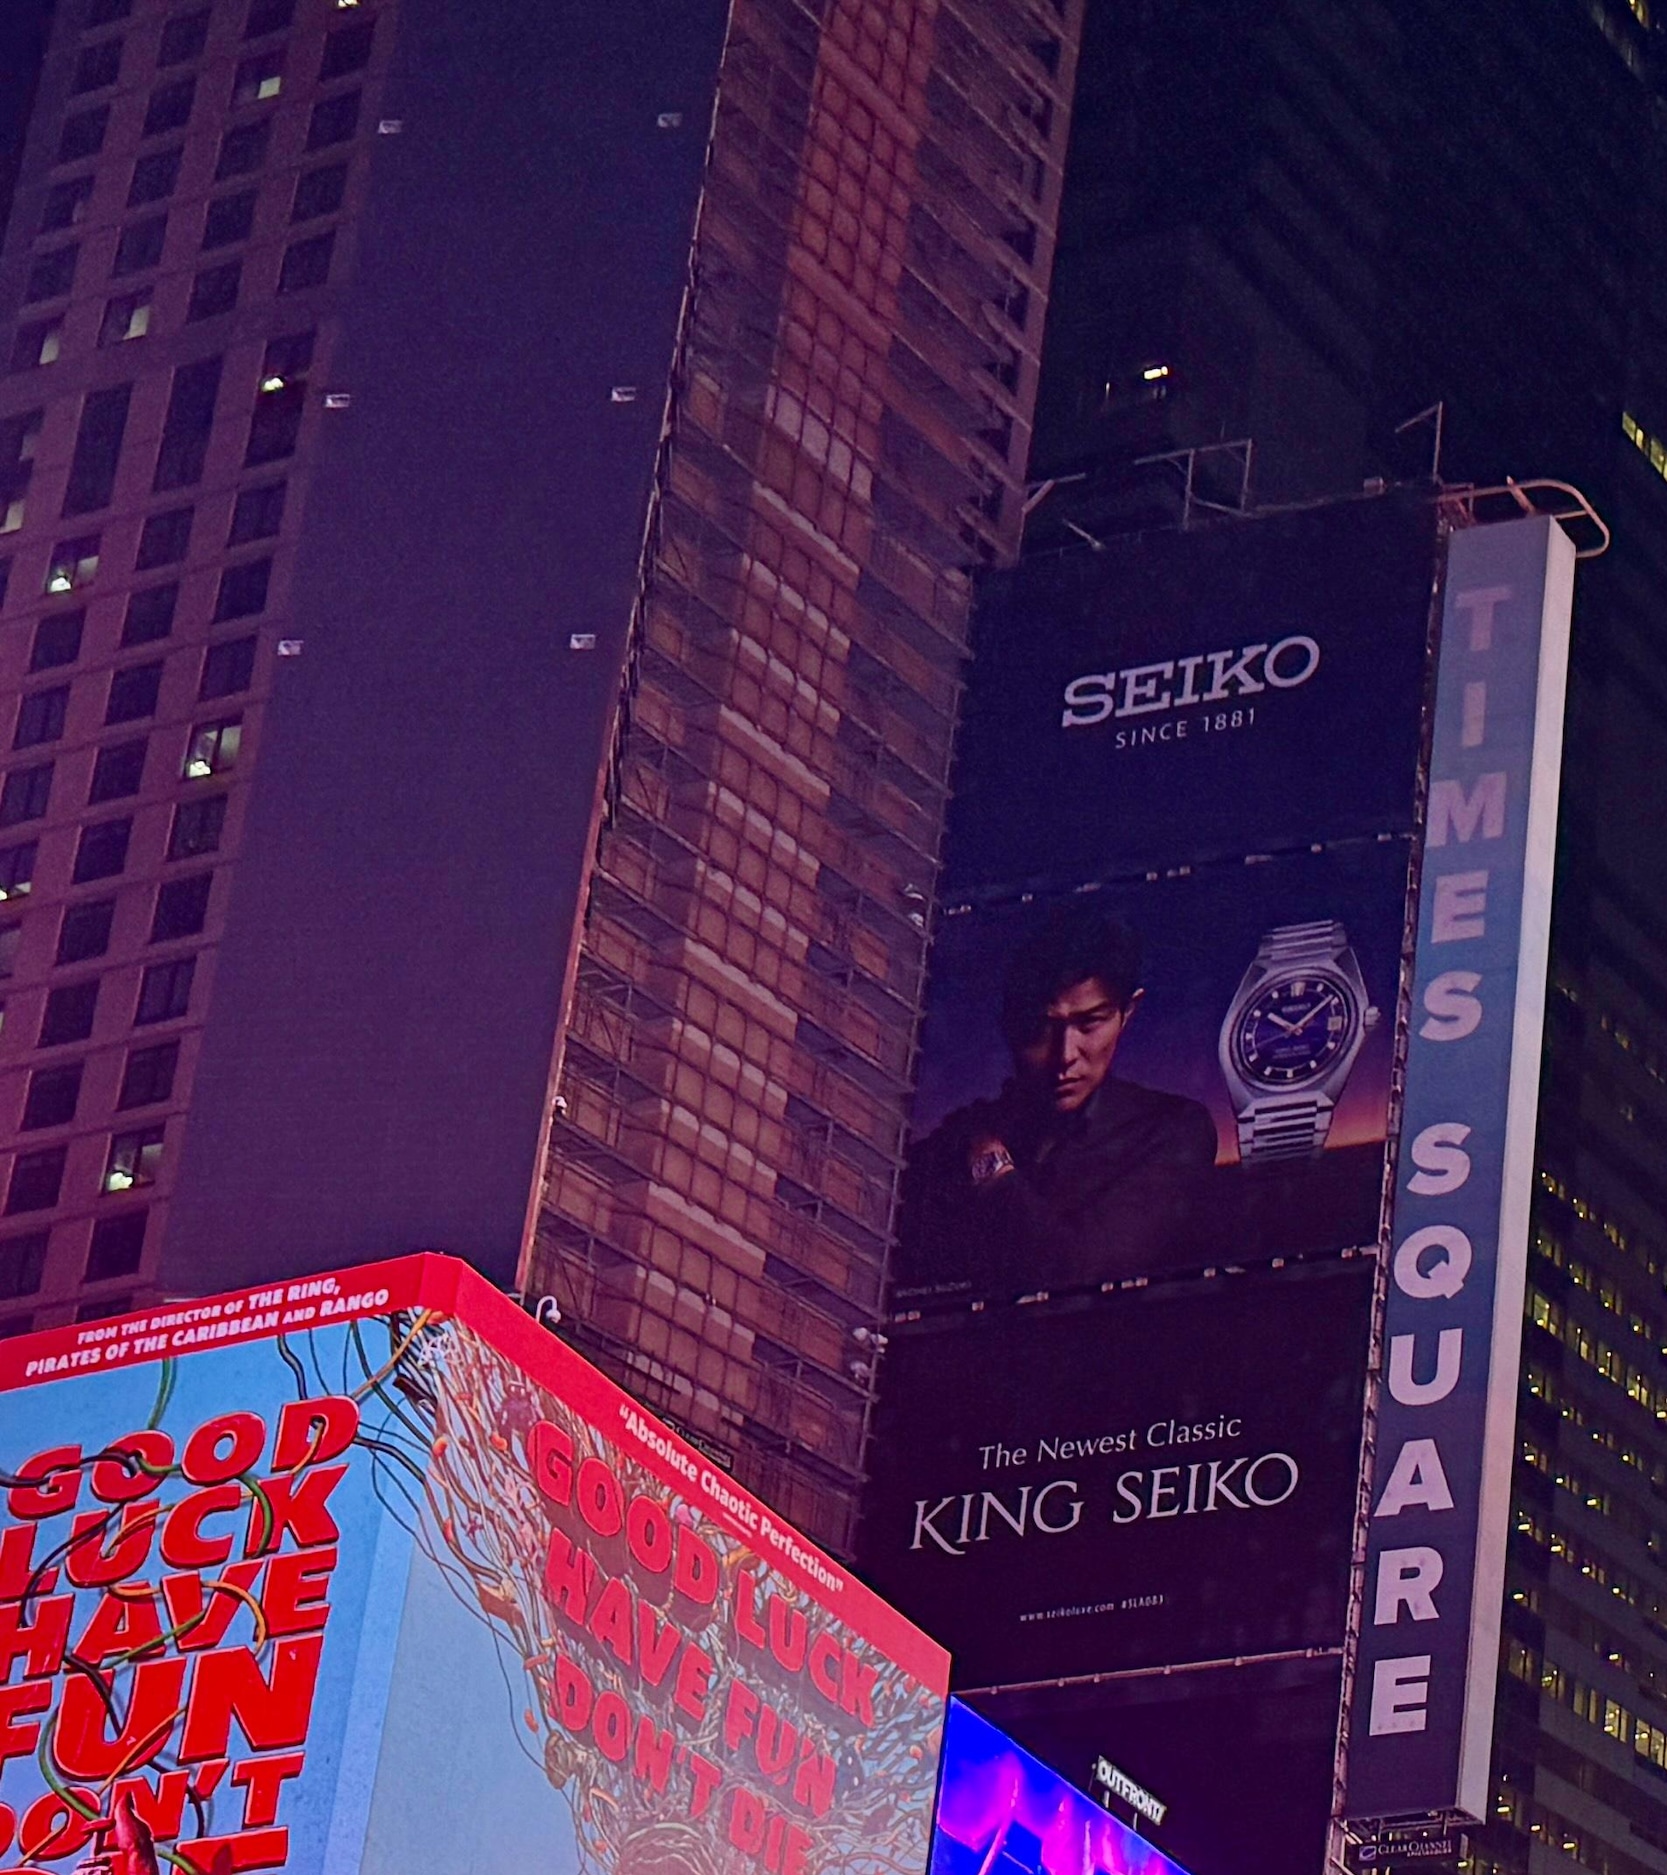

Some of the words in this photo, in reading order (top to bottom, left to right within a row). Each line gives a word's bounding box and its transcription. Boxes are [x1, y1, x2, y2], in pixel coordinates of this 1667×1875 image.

[1061, 635, 1320, 728] SEIKO
[1115, 719, 1189, 749] SINCE
[1203, 708, 1258, 733] 1881
[1419, 587, 1510, 1043] TIMES
[25, 1346, 102, 1376] PIRATES
[105, 1340, 130, 1361] OF
[133, 1333, 168, 1355] THE
[171, 1311, 279, 1347] CARIBBEAN
[282, 1306, 316, 1325] AND
[319, 1288, 389, 1316] RANGO
[77, 1324, 118, 1345] FROM
[121, 1318, 147, 1335] THE
[150, 1304, 222, 1331] DIRECTOR
[223, 1299, 243, 1315] OF
[248, 1289, 283, 1309] THE
[286, 1276, 341, 1302] RING,
[7, 1394, 360, 1520] GOOD
[979, 1444, 1027, 1472] The
[1038, 1429, 1137, 1461] Newest
[1147, 1414, 1243, 1450] Classic
[1369, 1123, 1473, 1737] SQUARE
[0, 1464, 350, 1599] LUCK
[700, 1469, 758, 1532] Chaotic
[909, 1480, 1084, 1556] KING
[1112, 1452, 1300, 1528] SEIKO
[0, 1545, 338, 1685] HAVE
[527, 1420, 718, 1604] GOOD
[735, 1569, 879, 1728] LUCK
[545, 1527, 715, 1721] HAVE
[723, 1678, 835, 1817] FUN
[555, 1653, 722, 1818] DON'T
